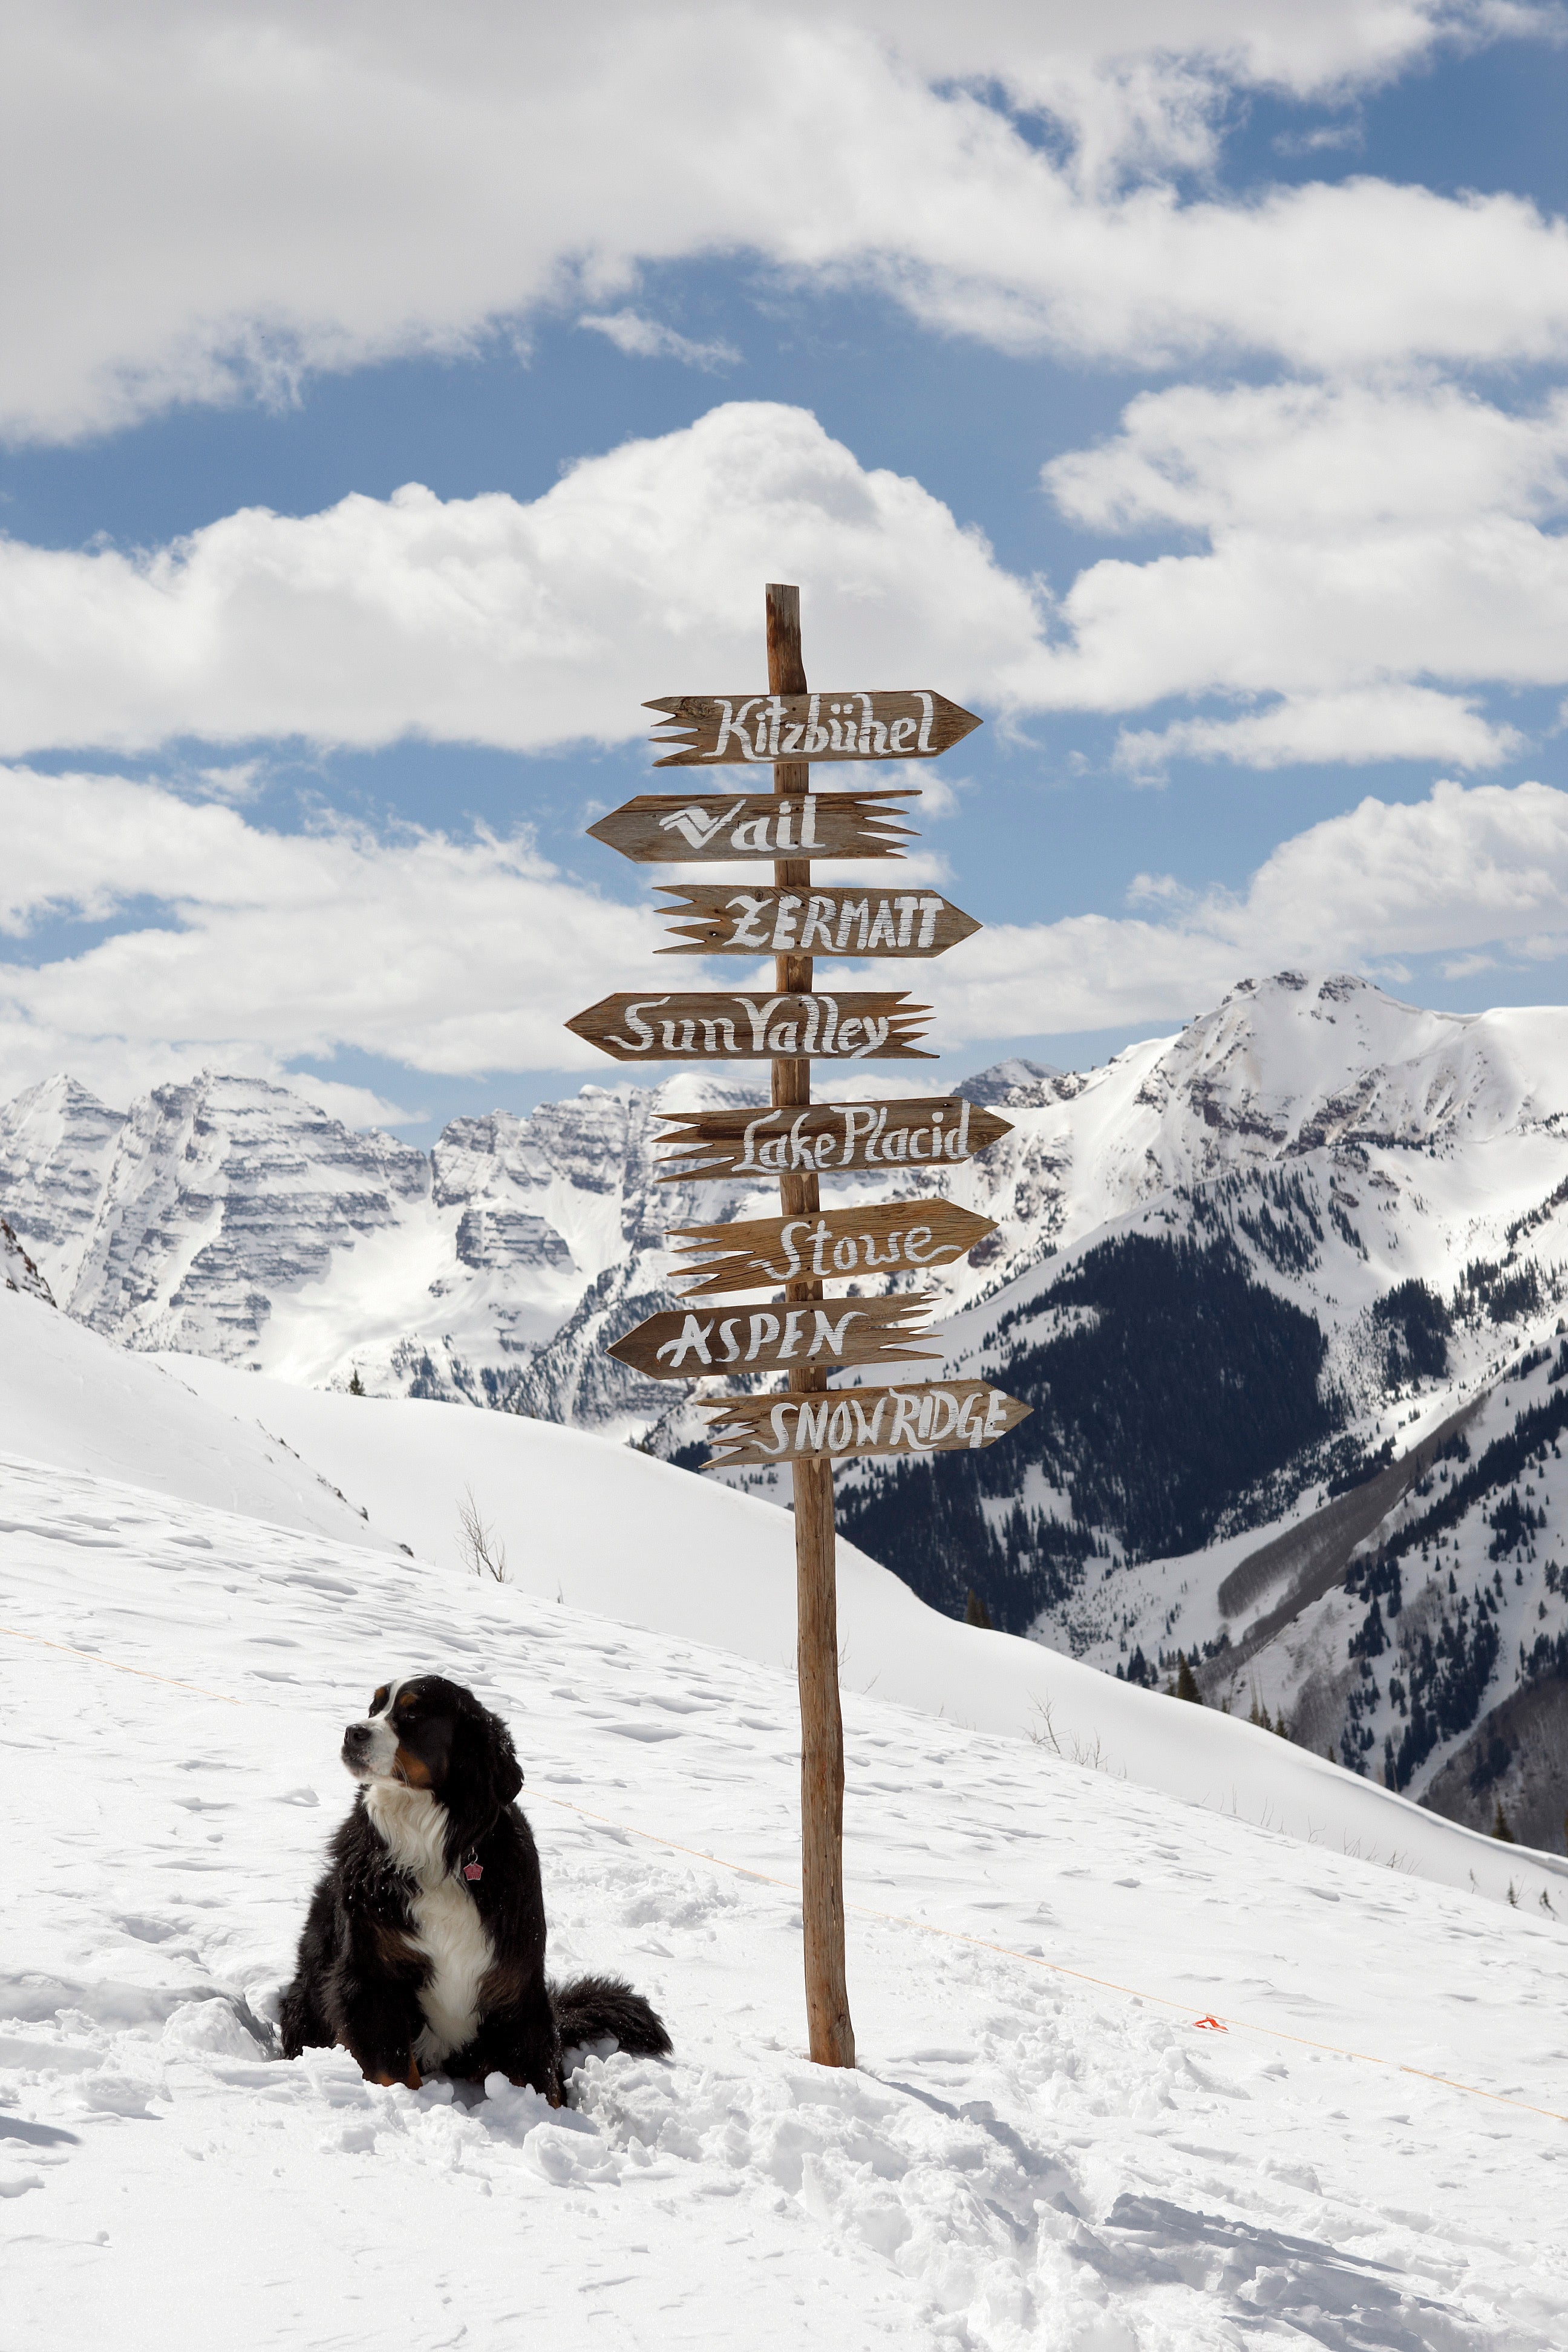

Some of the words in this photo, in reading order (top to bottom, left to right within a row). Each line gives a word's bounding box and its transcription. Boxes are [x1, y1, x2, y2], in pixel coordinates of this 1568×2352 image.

[702, 692, 938, 762] Kitzbühel
[659, 795, 825, 852] Vail
[722, 894, 948, 953] ZERMATT
[604, 996, 742, 1052] Sun
[732, 995, 890, 1059] Valley
[731, 1108, 835, 1175] Lake
[829, 1099, 971, 1166] Placid
[744, 1220, 962, 1281] Stowe
[656, 1310, 869, 1368] ASPEN
